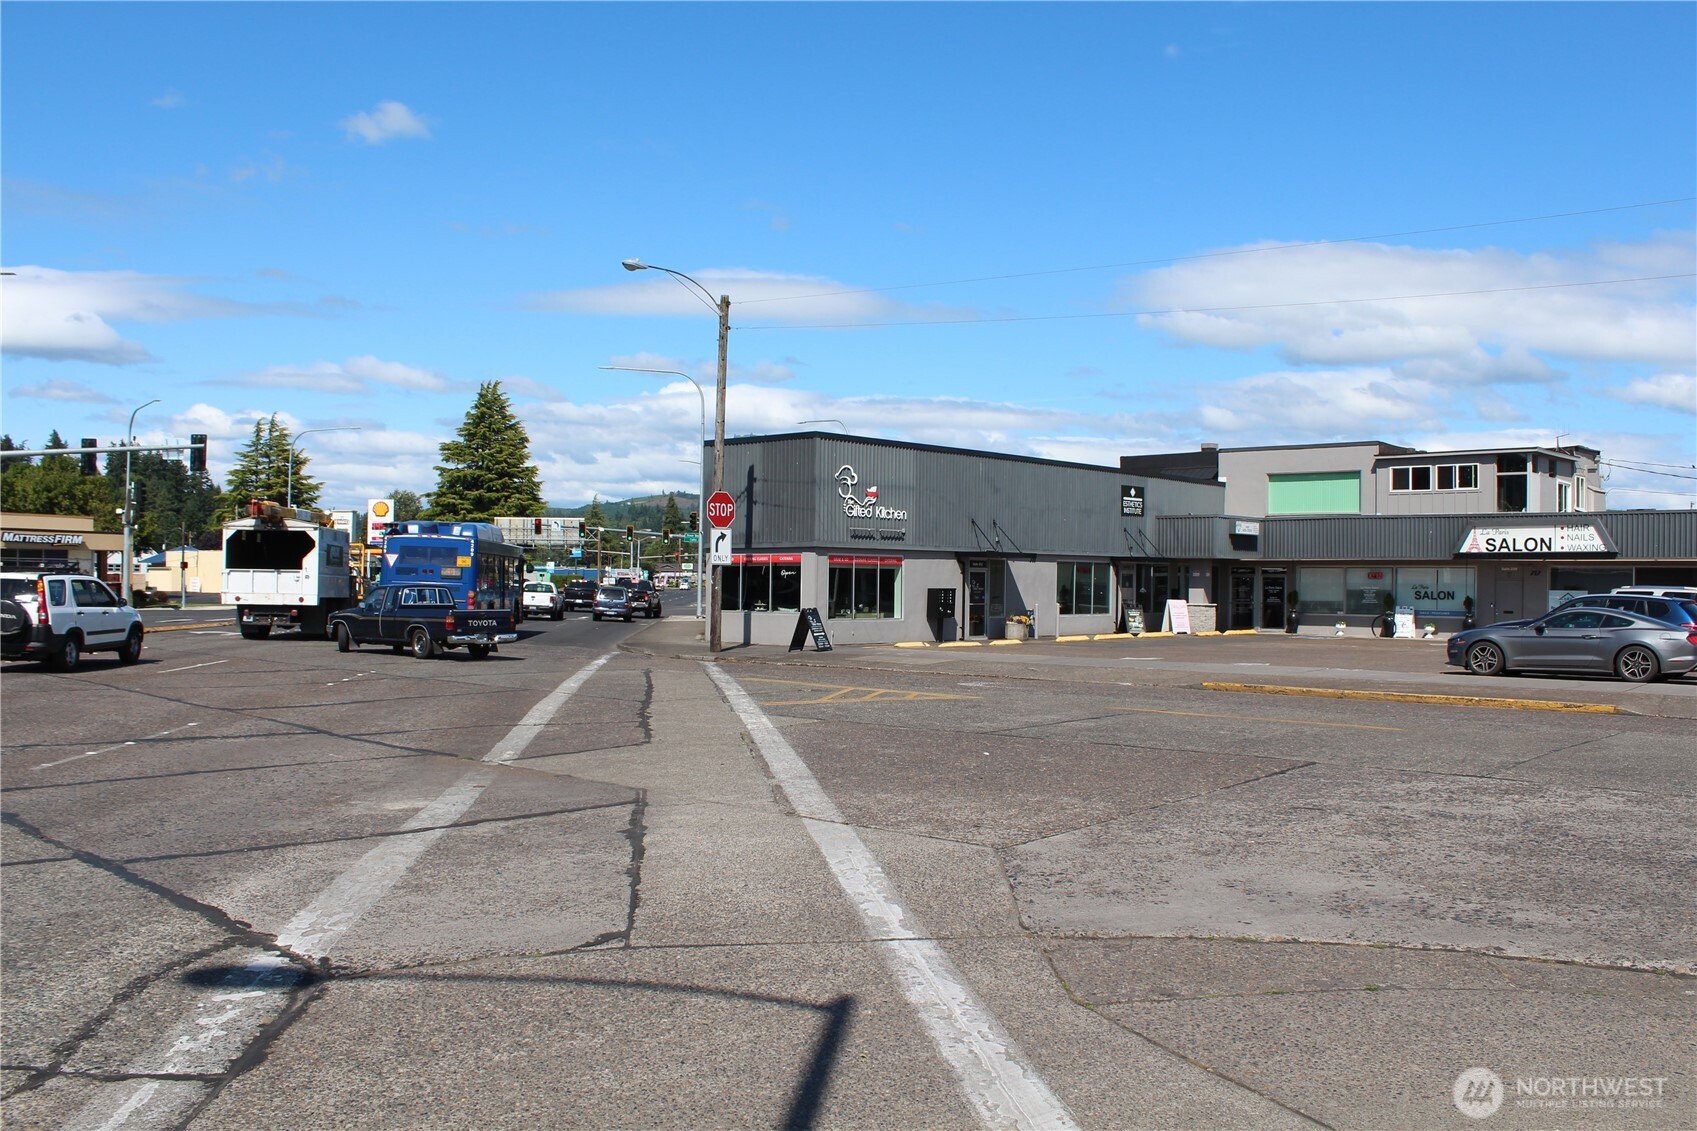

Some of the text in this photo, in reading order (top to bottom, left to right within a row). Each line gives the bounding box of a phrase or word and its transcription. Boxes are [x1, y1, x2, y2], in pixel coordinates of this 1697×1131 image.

[709, 502, 734, 517] STOP
[846, 504, 907, 520] Gifted Kitchen
[1480, 528, 1510, 536] La Paris
[1566, 523, 1590, 532] HAIR
[1566, 533, 1595, 542] NAILS
[1485, 537, 1552, 552] SALON
[1566, 543, 1607, 552] WAXING
[713, 554, 729, 562] ONLY
[780, 569, 797, 579] Open
[1414, 591, 1455, 600] SALON
[468, 619, 497, 627] TOYOTA
